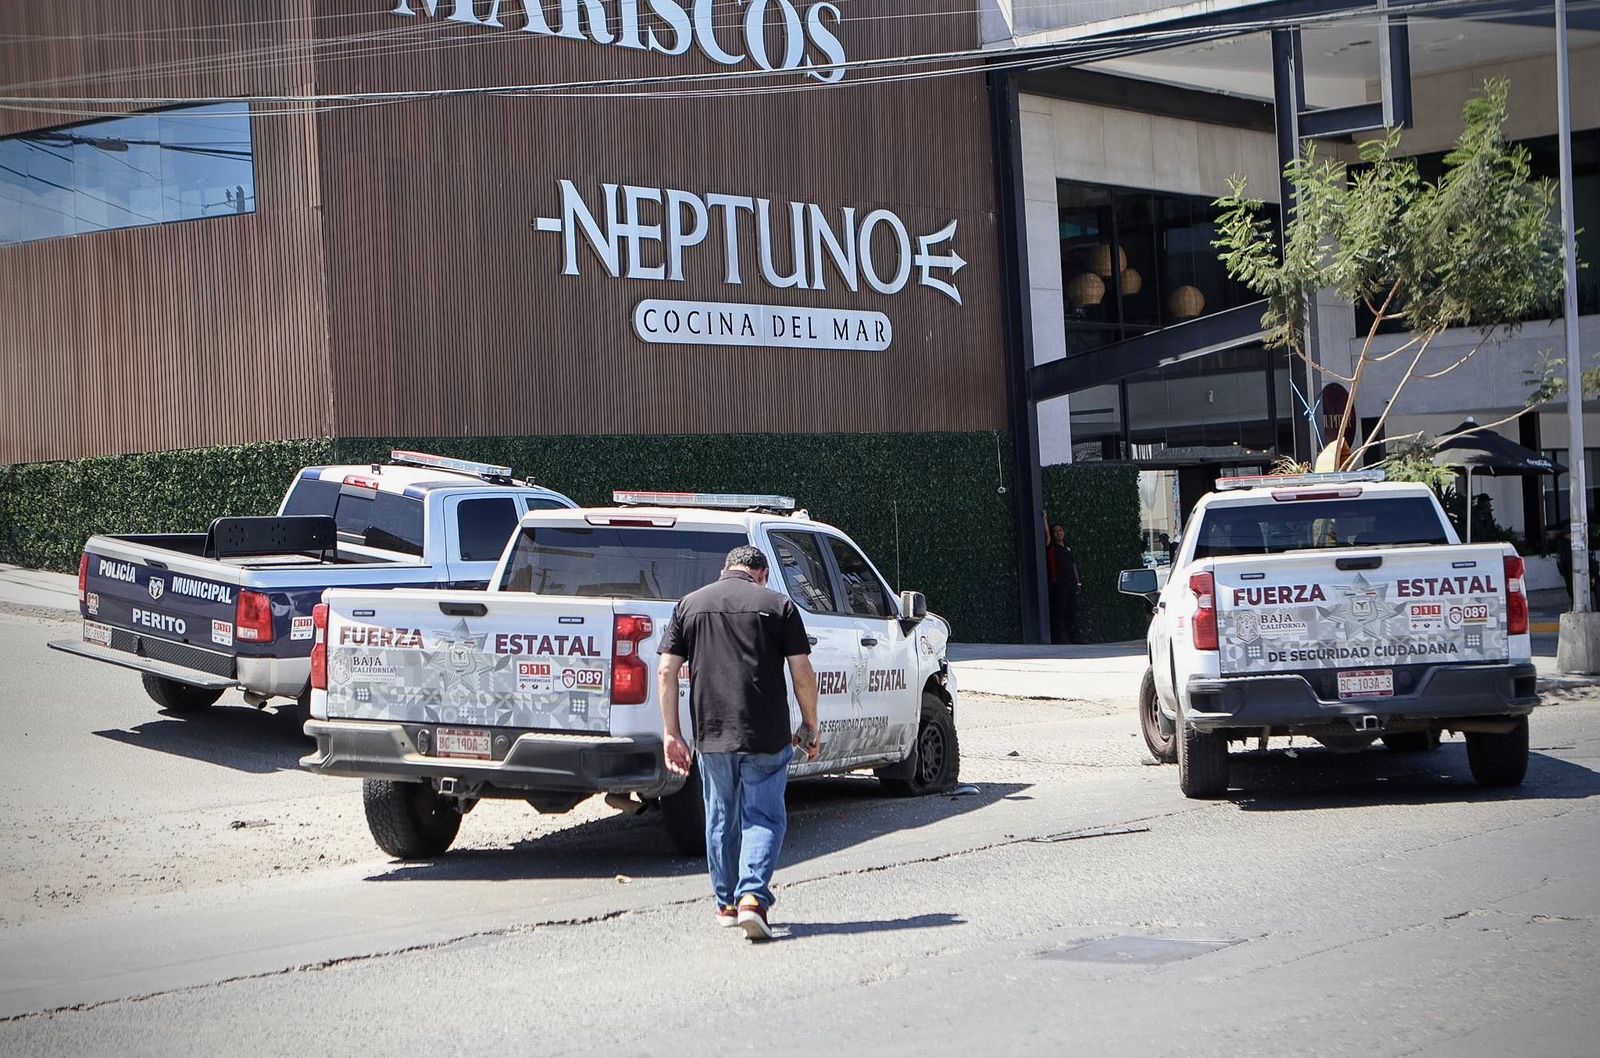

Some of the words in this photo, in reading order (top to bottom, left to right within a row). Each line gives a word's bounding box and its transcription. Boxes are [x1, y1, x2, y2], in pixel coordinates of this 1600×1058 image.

[391, 0, 847, 83] ISCOS
[557, 179, 913, 296] NEPTUNO
[643, 308, 755, 337] COCINA
[772, 314, 818, 340] DEL
[833, 317, 887, 343] MAR
[99, 559, 136, 583] POLICÍA
[172, 576, 232, 604] MUNICIPAL
[1233, 583, 1326, 607] FUERZA
[1397, 574, 1498, 598] ESTATAL
[132, 608, 187, 635] PERITO
[1260, 613, 1293, 624] BAJA
[1411, 605, 1441, 616] 911
[1464, 606, 1487, 618] 089
[1260, 622, 1307, 631] CALIFORNIA
[339, 626, 424, 649] FUERZA
[495, 633, 602, 657] ESTATAL
[1268, 650, 1287, 663] DE
[1290, 646, 1370, 662] SEGURIDAD
[1373, 642, 1458, 657] CIUDADANA
[353, 656, 382, 667] BAJA
[520, 664, 551, 675] 911
[577, 671, 602, 685] 089
[868, 668, 907, 693] ESTATAL
